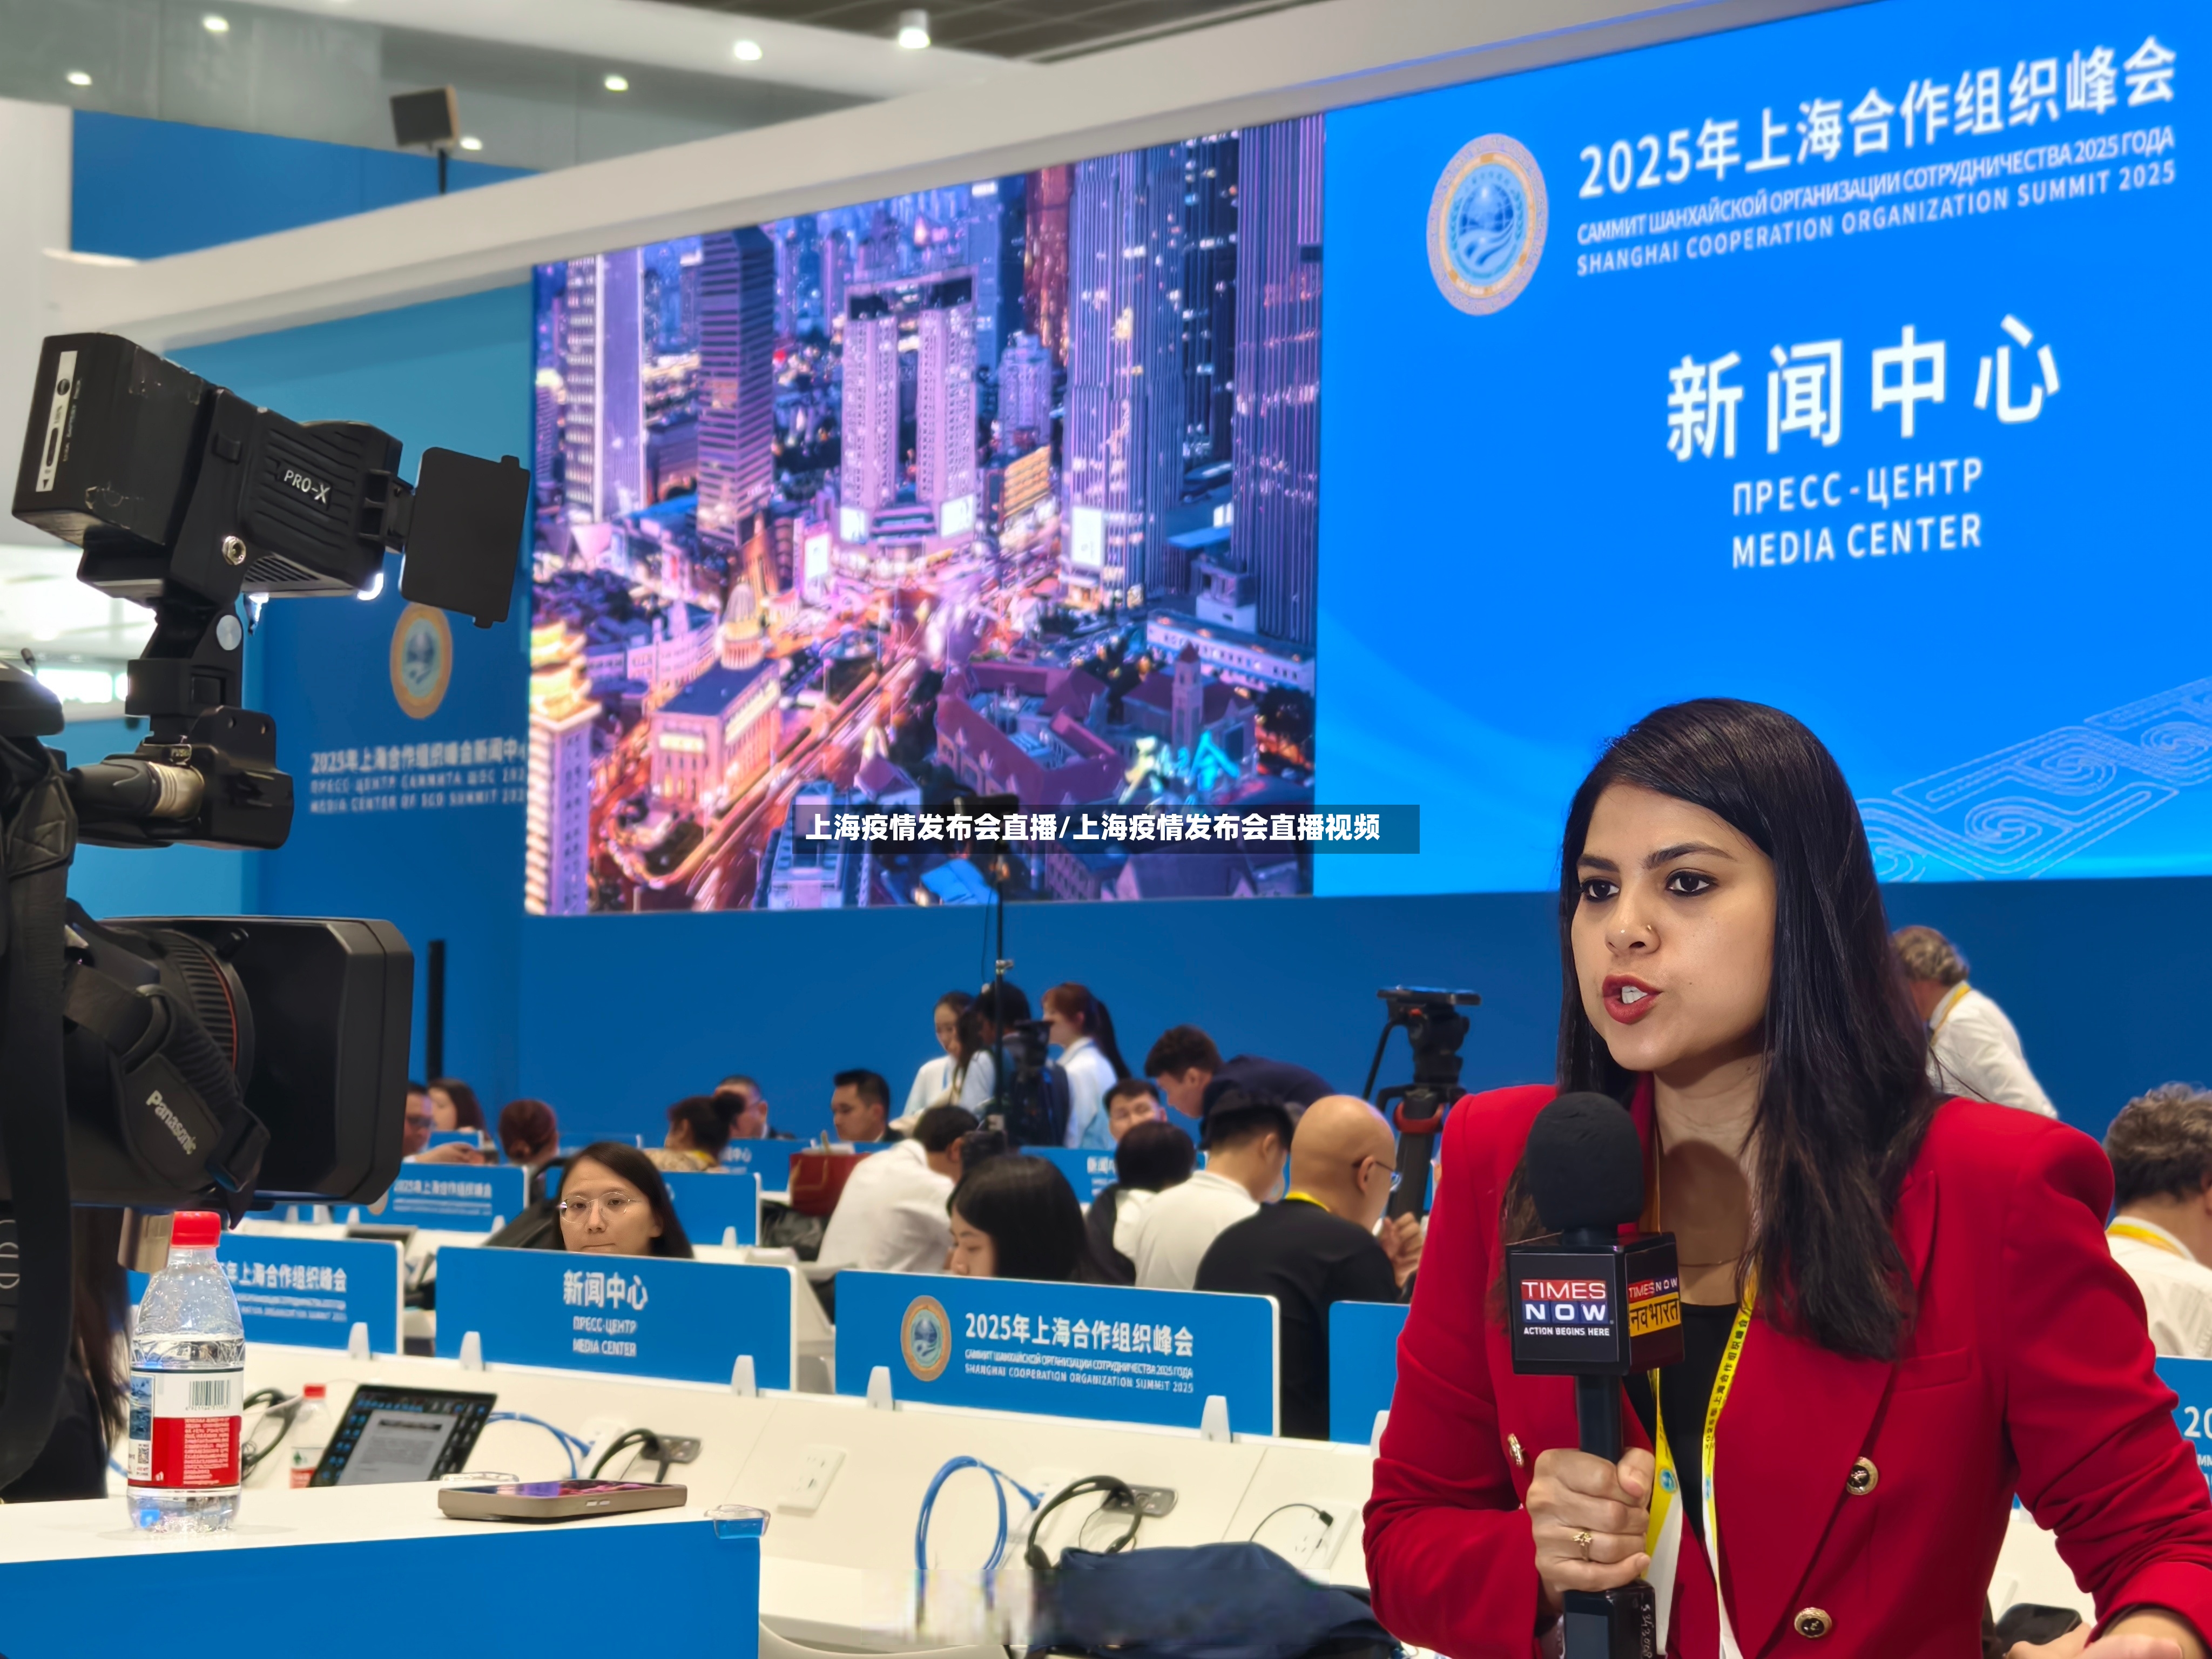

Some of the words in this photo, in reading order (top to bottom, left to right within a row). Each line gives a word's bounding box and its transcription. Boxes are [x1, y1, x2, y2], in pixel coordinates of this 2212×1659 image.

[1579, 35, 2176, 198] 2025年上海合作组织峰会
[1577, 214, 1646, 245] САММИТ
[1650, 188, 1767, 233] ШАНХАЙСКОЙ
[1770, 176, 1899, 212] ОРГАНИЗАЦИИ
[1903, 146, 2073, 191] СОТРУДНИЧЕСТВА
[2074, 134, 2119, 165] 2025
[2122, 125, 2175, 158] ГОДА
[1577, 240, 1677, 276] SHANGHAI
[1687, 216, 1833, 259] COOPERATION
[1842, 188, 2008, 235] ORGANIZATION
[2018, 169, 2110, 207] SUMMIT
[2119, 159, 2176, 191] 2025
[1667, 314, 2060, 462] 新闻中心
[284, 469, 331, 503] PRO-X
[1733, 527, 1835, 569] MEDIA
[1847, 514, 1982, 558] CENTER
[146, 1090, 196, 1155] Panasonic
[563, 1269, 648, 1310] 新闻中心
[1522, 1282, 1606, 1299] TIMES
[1629, 1282, 1655, 1298] TIMES
[1656, 1277, 1677, 1291] NOW
[1523, 1327, 1553, 1336] ACTION
[1555, 1327, 1585, 1336] BEGINS
[1588, 1327, 1610, 1337] HERE
[1526, 1304, 1606, 1321] NOW
[572, 1338, 599, 1353] MEDIA
[601, 1340, 636, 1357] CENTER
[965, 1312, 1193, 1357] 2025年上海合作组织峰会
[965, 1363, 1006, 1376] SHANGHAI
[1009, 1367, 1067, 1382] COOPERATION
[1069, 1373, 1132, 1387] ORGANIZATION
[1136, 1378, 1170, 1391] SUMMIT
[1173, 1382, 1193, 1393] 2025
